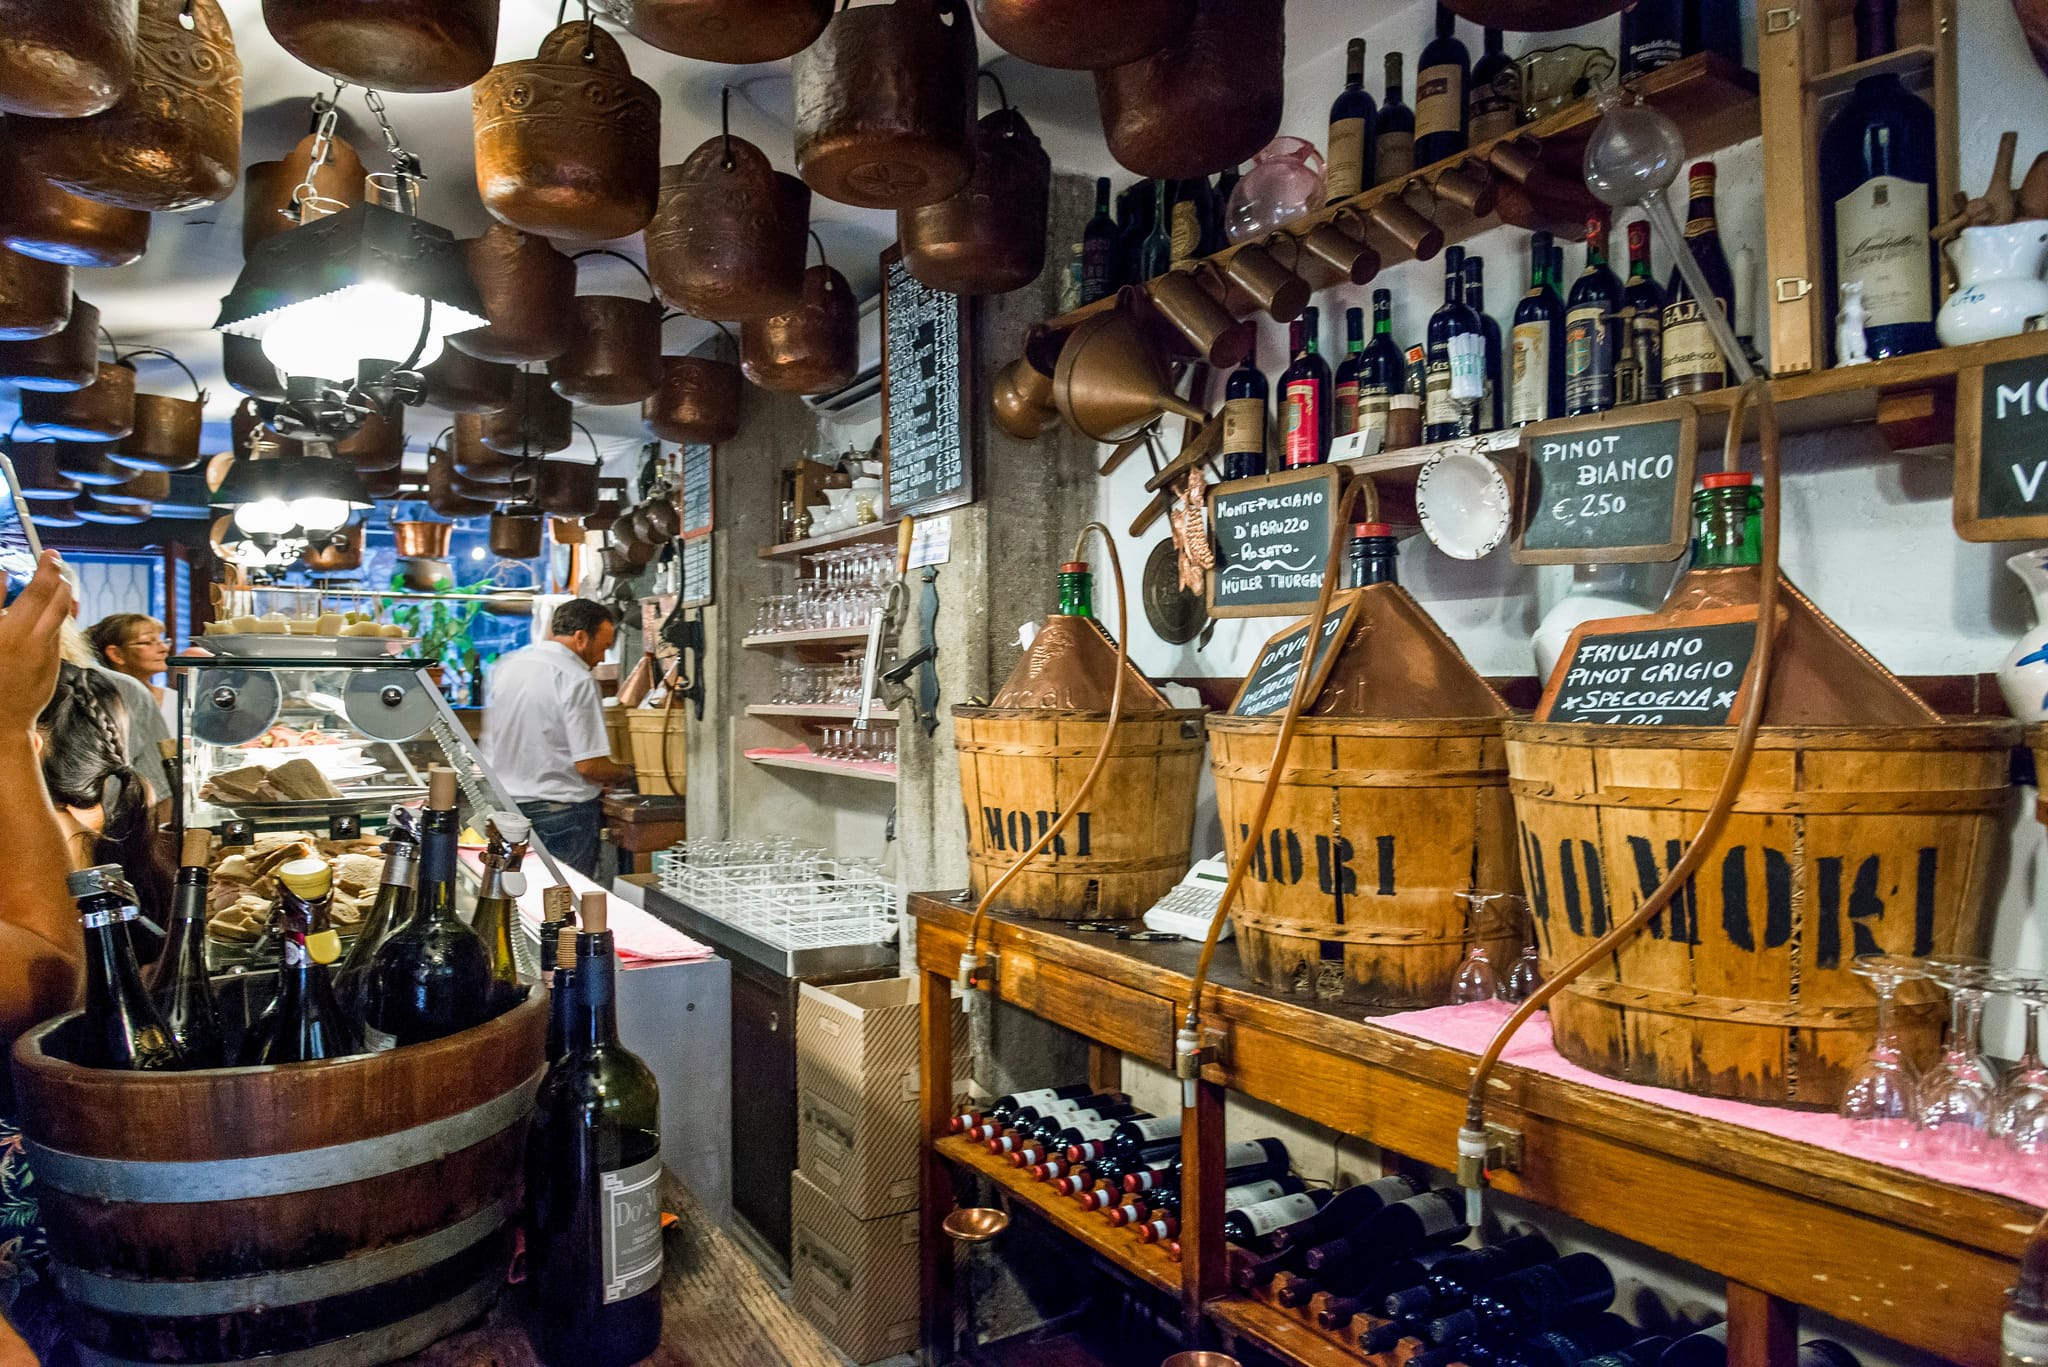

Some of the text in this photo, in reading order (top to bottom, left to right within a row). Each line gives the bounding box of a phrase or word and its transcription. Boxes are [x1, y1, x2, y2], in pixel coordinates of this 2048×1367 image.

[1996, 378, 2048, 419] M
[1542, 435, 1620, 463] PINOT
[1576, 454, 1674, 486] BIANCO
[1217, 491, 1324, 519] MONTEPULCIANO
[1233, 517, 1310, 540] D'ABRUZZO
[1577, 637, 1704, 664] FRIULANO
[1567, 660, 1734, 688] PINOT GRIGIO
[983, 806, 1093, 857] MORI
[1626, 835, 1939, 971] MORI
